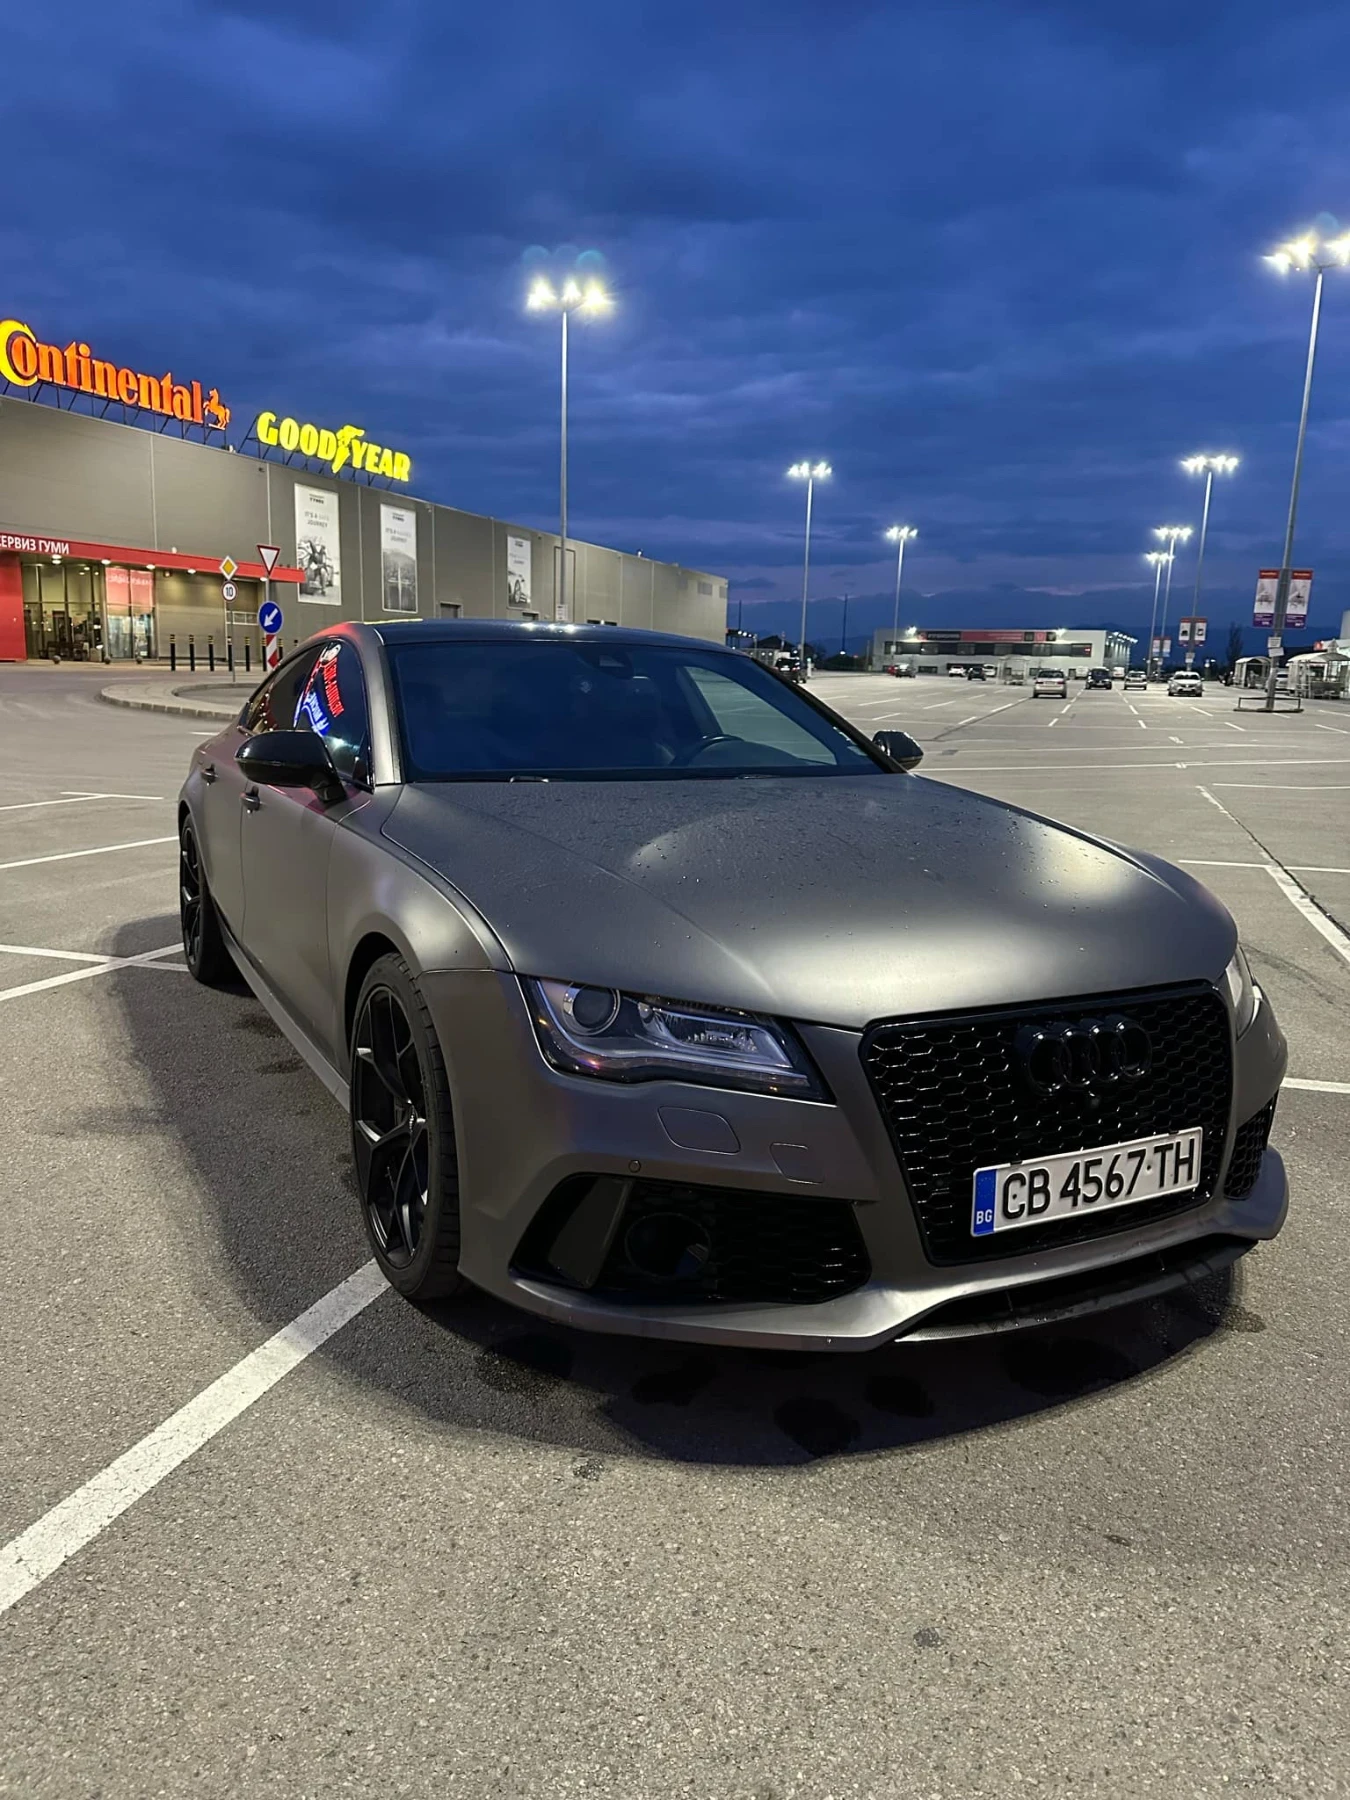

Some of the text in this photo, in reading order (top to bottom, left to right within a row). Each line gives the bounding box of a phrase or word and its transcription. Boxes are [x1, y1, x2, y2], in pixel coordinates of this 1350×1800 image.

[0, 319, 203, 423] Continental
[0, 535, 70, 555] ЕРВИЗ ГУМИ
[225, 586, 234, 597] 10
[1002, 1138, 1195, 1220] CB 4567 TH
[976, 1209, 993, 1225] BG
